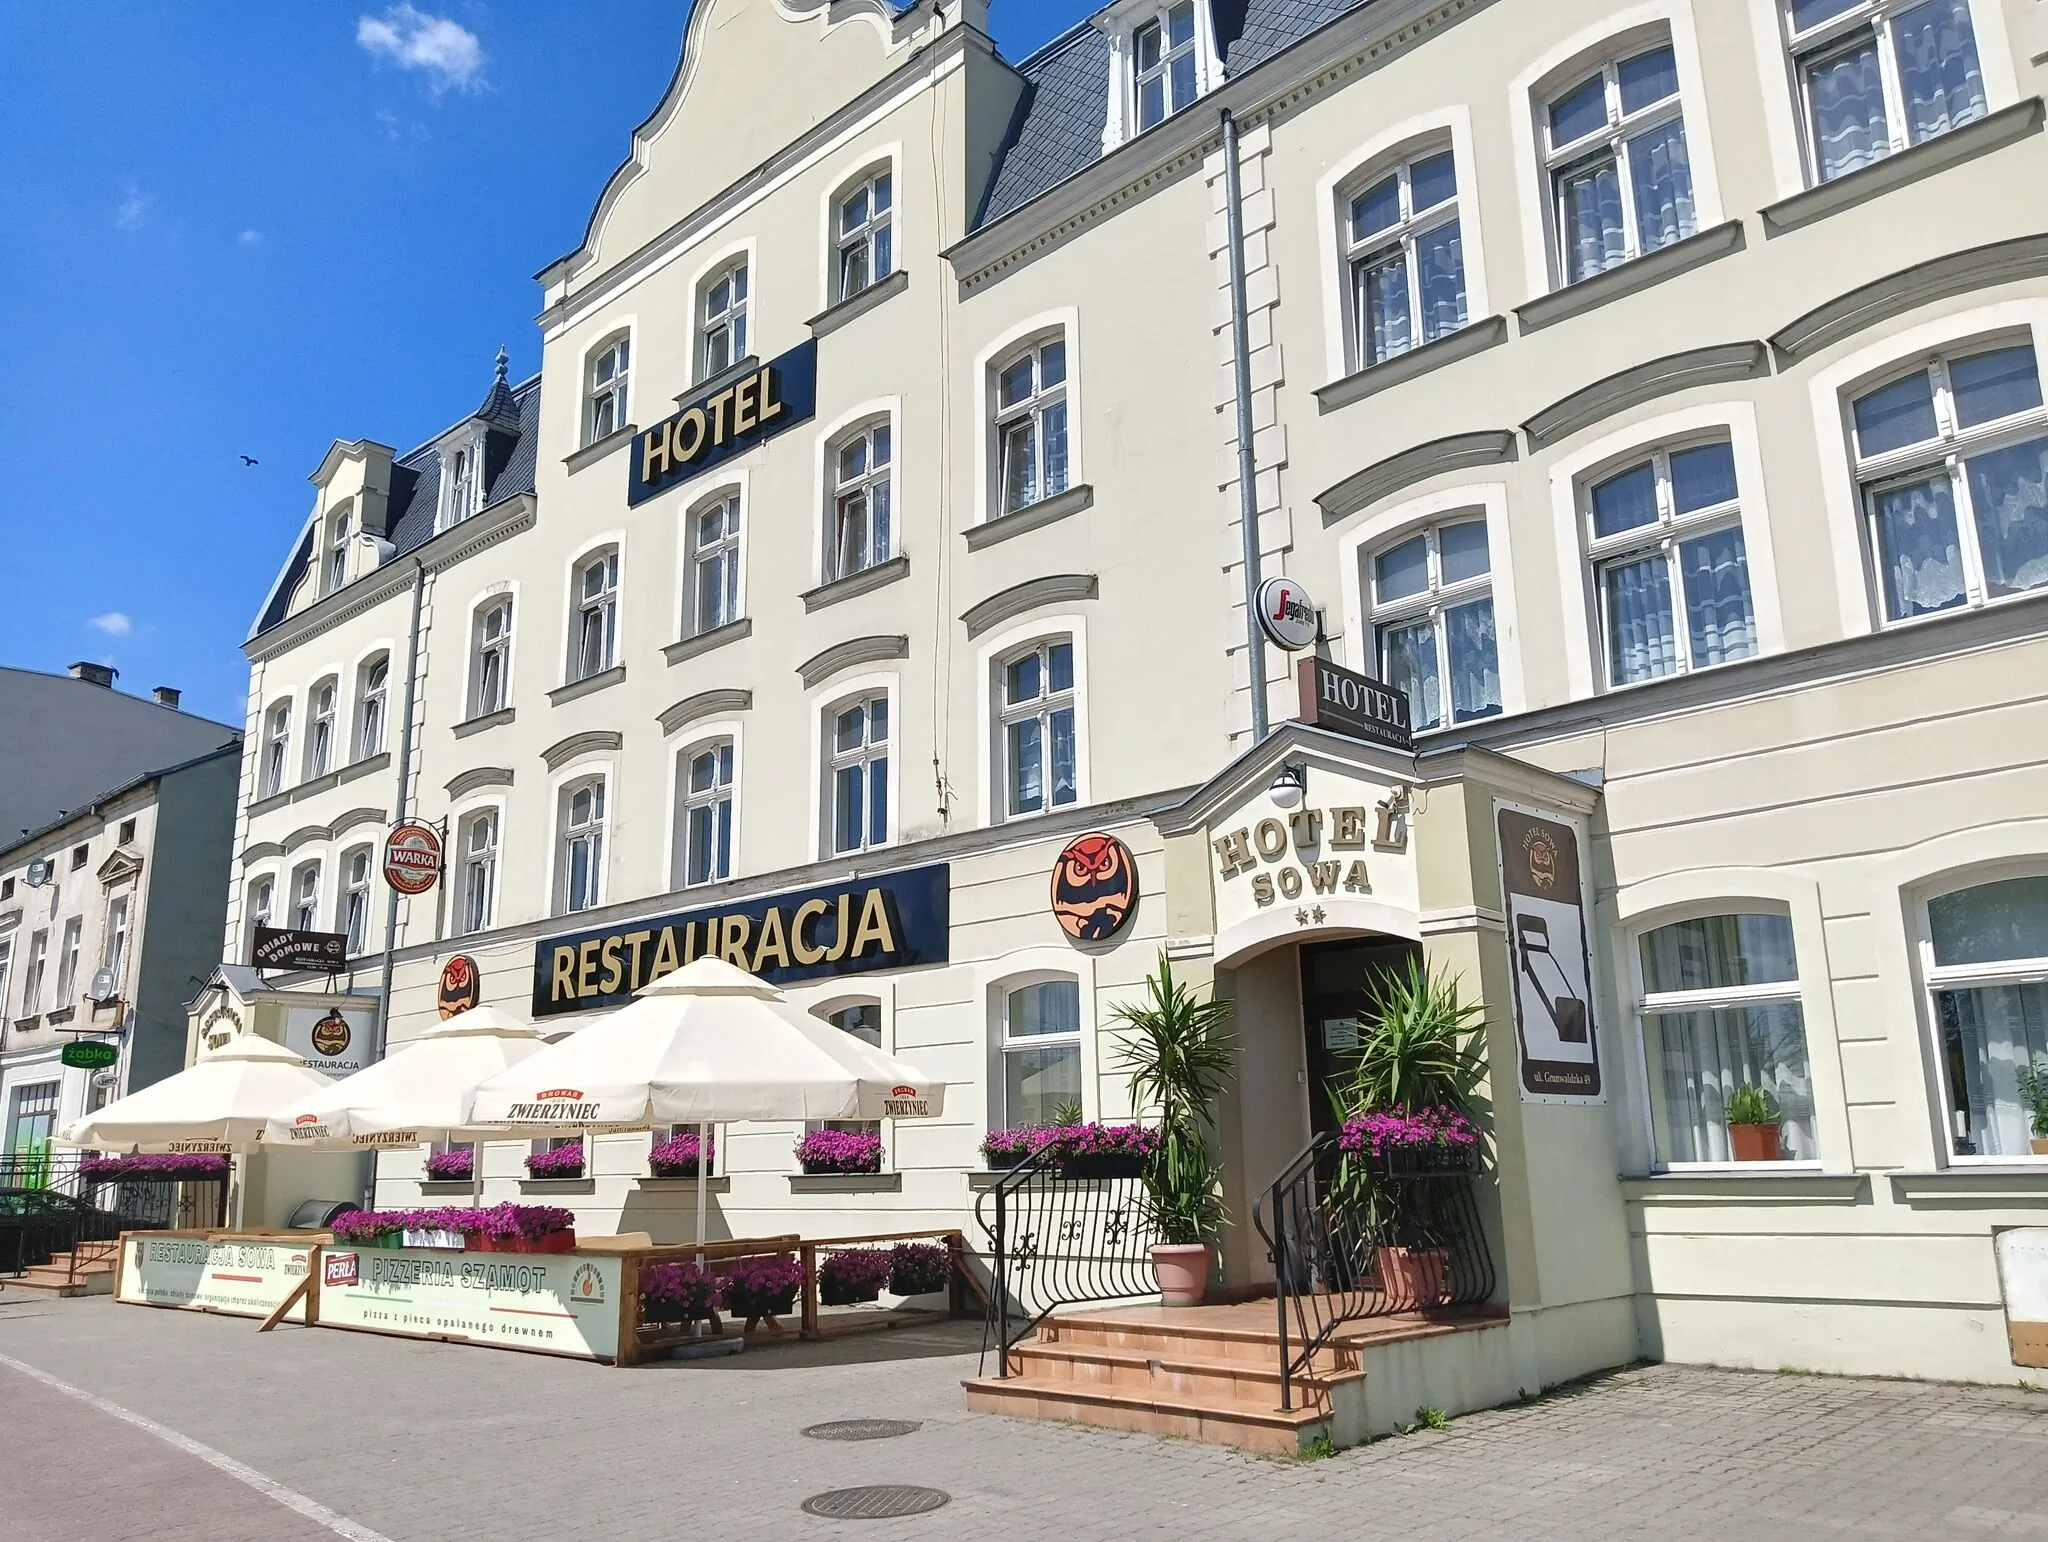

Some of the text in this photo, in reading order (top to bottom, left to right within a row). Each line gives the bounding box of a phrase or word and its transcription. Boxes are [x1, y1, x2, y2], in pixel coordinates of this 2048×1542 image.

[642, 366, 781, 483] HOTEL
[1320, 668, 1407, 729] HOTEL
[1212, 806, 1408, 874] HOTEL
[1522, 827, 1540, 850] HOTEL
[392, 850, 434, 867] WARKA
[1252, 860, 1371, 903] SOWA
[257, 932, 294, 957] OBIADY
[269, 942, 319, 962] DOMOWE
[551, 888, 895, 1001] RESTAURACJA
[300, 1060, 359, 1070] ESTAURACJA
[541, 1090, 579, 1099] BROWAR
[507, 1103, 600, 1119] ZWIERZYNIEC
[884, 1100, 928, 1115] ZWIERZYNIEC
[289, 1125, 329, 1140] ZWIERZYNIEC
[150, 1242, 276, 1270] RESTAURACJA SOWA
[328, 1262, 357, 1280] PERŁA
[372, 1257, 547, 1293] PIZZERIA SZAMOT
[363, 1309, 388, 1319] pizza
[403, 1313, 431, 1324] pieca
[437, 1318, 494, 1333] opalanego
[501, 1323, 554, 1339] drewnem
